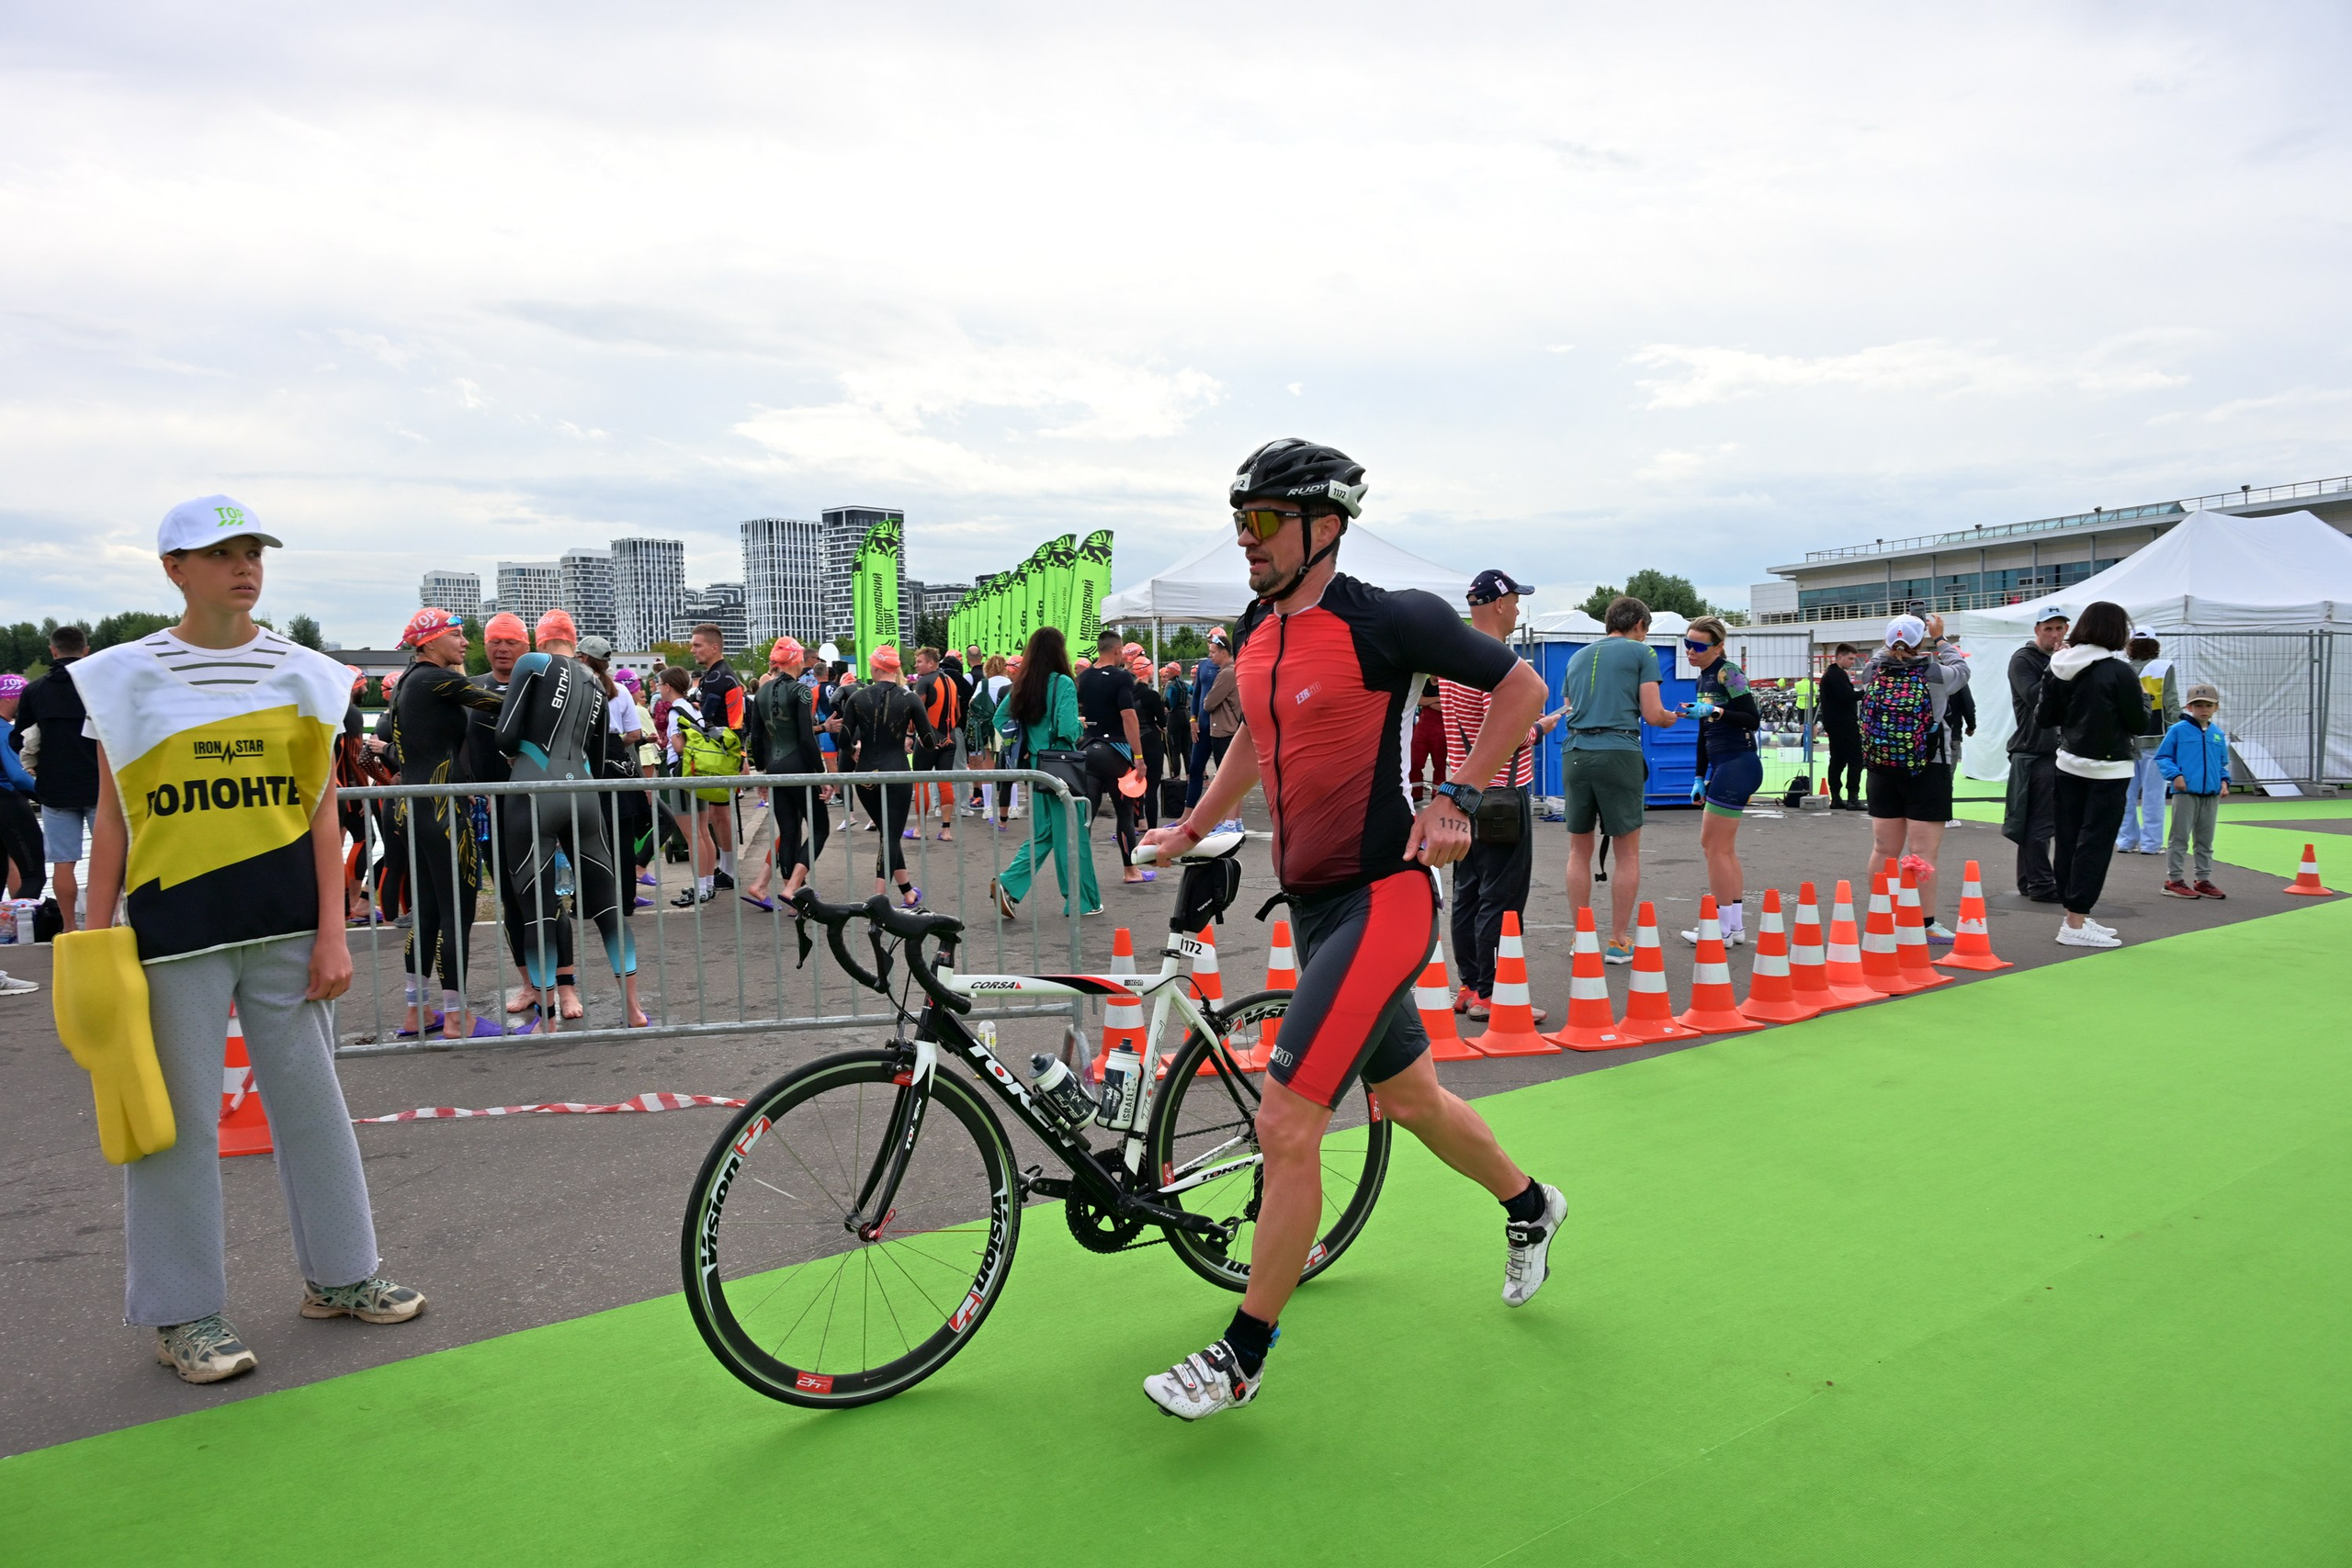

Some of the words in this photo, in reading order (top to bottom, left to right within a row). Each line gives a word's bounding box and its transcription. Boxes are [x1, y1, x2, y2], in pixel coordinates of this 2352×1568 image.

[1287, 483, 1329, 496] RUDY
[1333, 488, 1347, 499] 1172
[214, 507, 244, 519] TOP
[1080, 579, 1094, 641] МОСКОВСКИЙ
[411, 610, 435, 631] TOP
[884, 607, 897, 636] СПОРТ
[551, 666, 569, 709] HUUB
[194, 740, 221, 754] IRON
[235, 739, 264, 752] STAR
[1440, 817, 1468, 833] 1172
[1180, 938, 1203, 955] 1172
[970, 981, 1016, 989] CORSA
[1122, 1093, 1134, 1122] ISRAEL
[1201, 1158, 1256, 1181] TOKEN
[1508, 1229, 1528, 1242] SIDI
